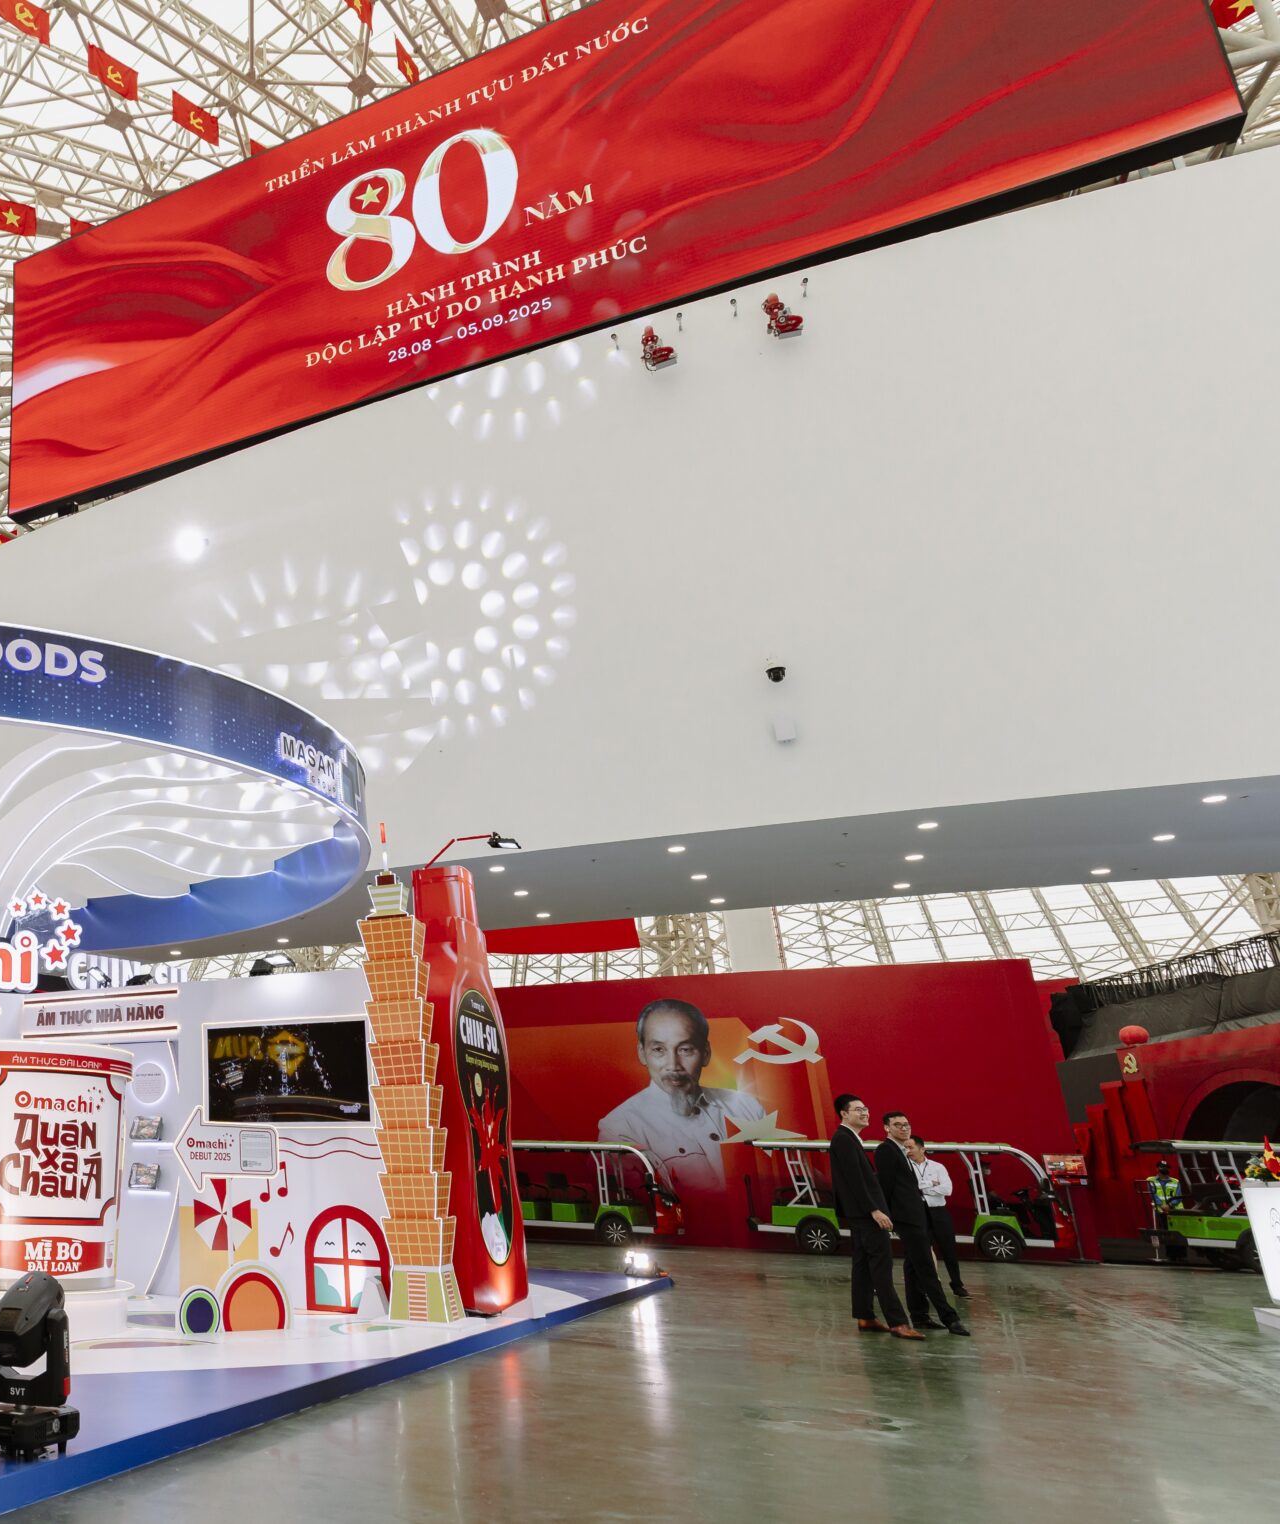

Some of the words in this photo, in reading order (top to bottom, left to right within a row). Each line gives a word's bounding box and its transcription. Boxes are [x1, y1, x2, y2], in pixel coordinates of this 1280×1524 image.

[265, 157, 325, 193] TRIỂN
[331, 135, 377, 166] LÃM
[382, 98, 461, 143] THÀNH
[466, 75, 515, 106] TỰU
[520, 52, 570, 84] ĐẤT
[575, 16, 650, 60] NƯỚC
[326, 128, 518, 291] 80
[523, 183, 595, 226] NĂM
[305, 339, 353, 368] ĐỘC
[357, 322, 402, 350] LẬP
[409, 306, 440, 332] TỰ
[446, 295, 482, 320] DO
[489, 264, 567, 304] HẠNH
[572, 236, 648, 275] PHÚC
[386, 285, 456, 319] HÀNH
[461, 249, 542, 290] TRÌNH
[388, 338, 432, 364] 28.08
[456, 297, 553, 340] 05.09.2025
[282, 735, 336, 780] MASAN
[59, 1009, 92, 1027] THỰC
[96, 1004, 123, 1022] NHÀ
[126, 1002, 164, 1022] HÀNG
[15, 1091, 93, 1113] Omachi
[186, 1137, 227, 1149] Omachi
[190, 1151, 212, 1160] DEBUT
[214, 1151, 231, 1161] 2025
[51, 1261, 80, 1272] LOAN
[9, 1387, 26, 1396] SVT
